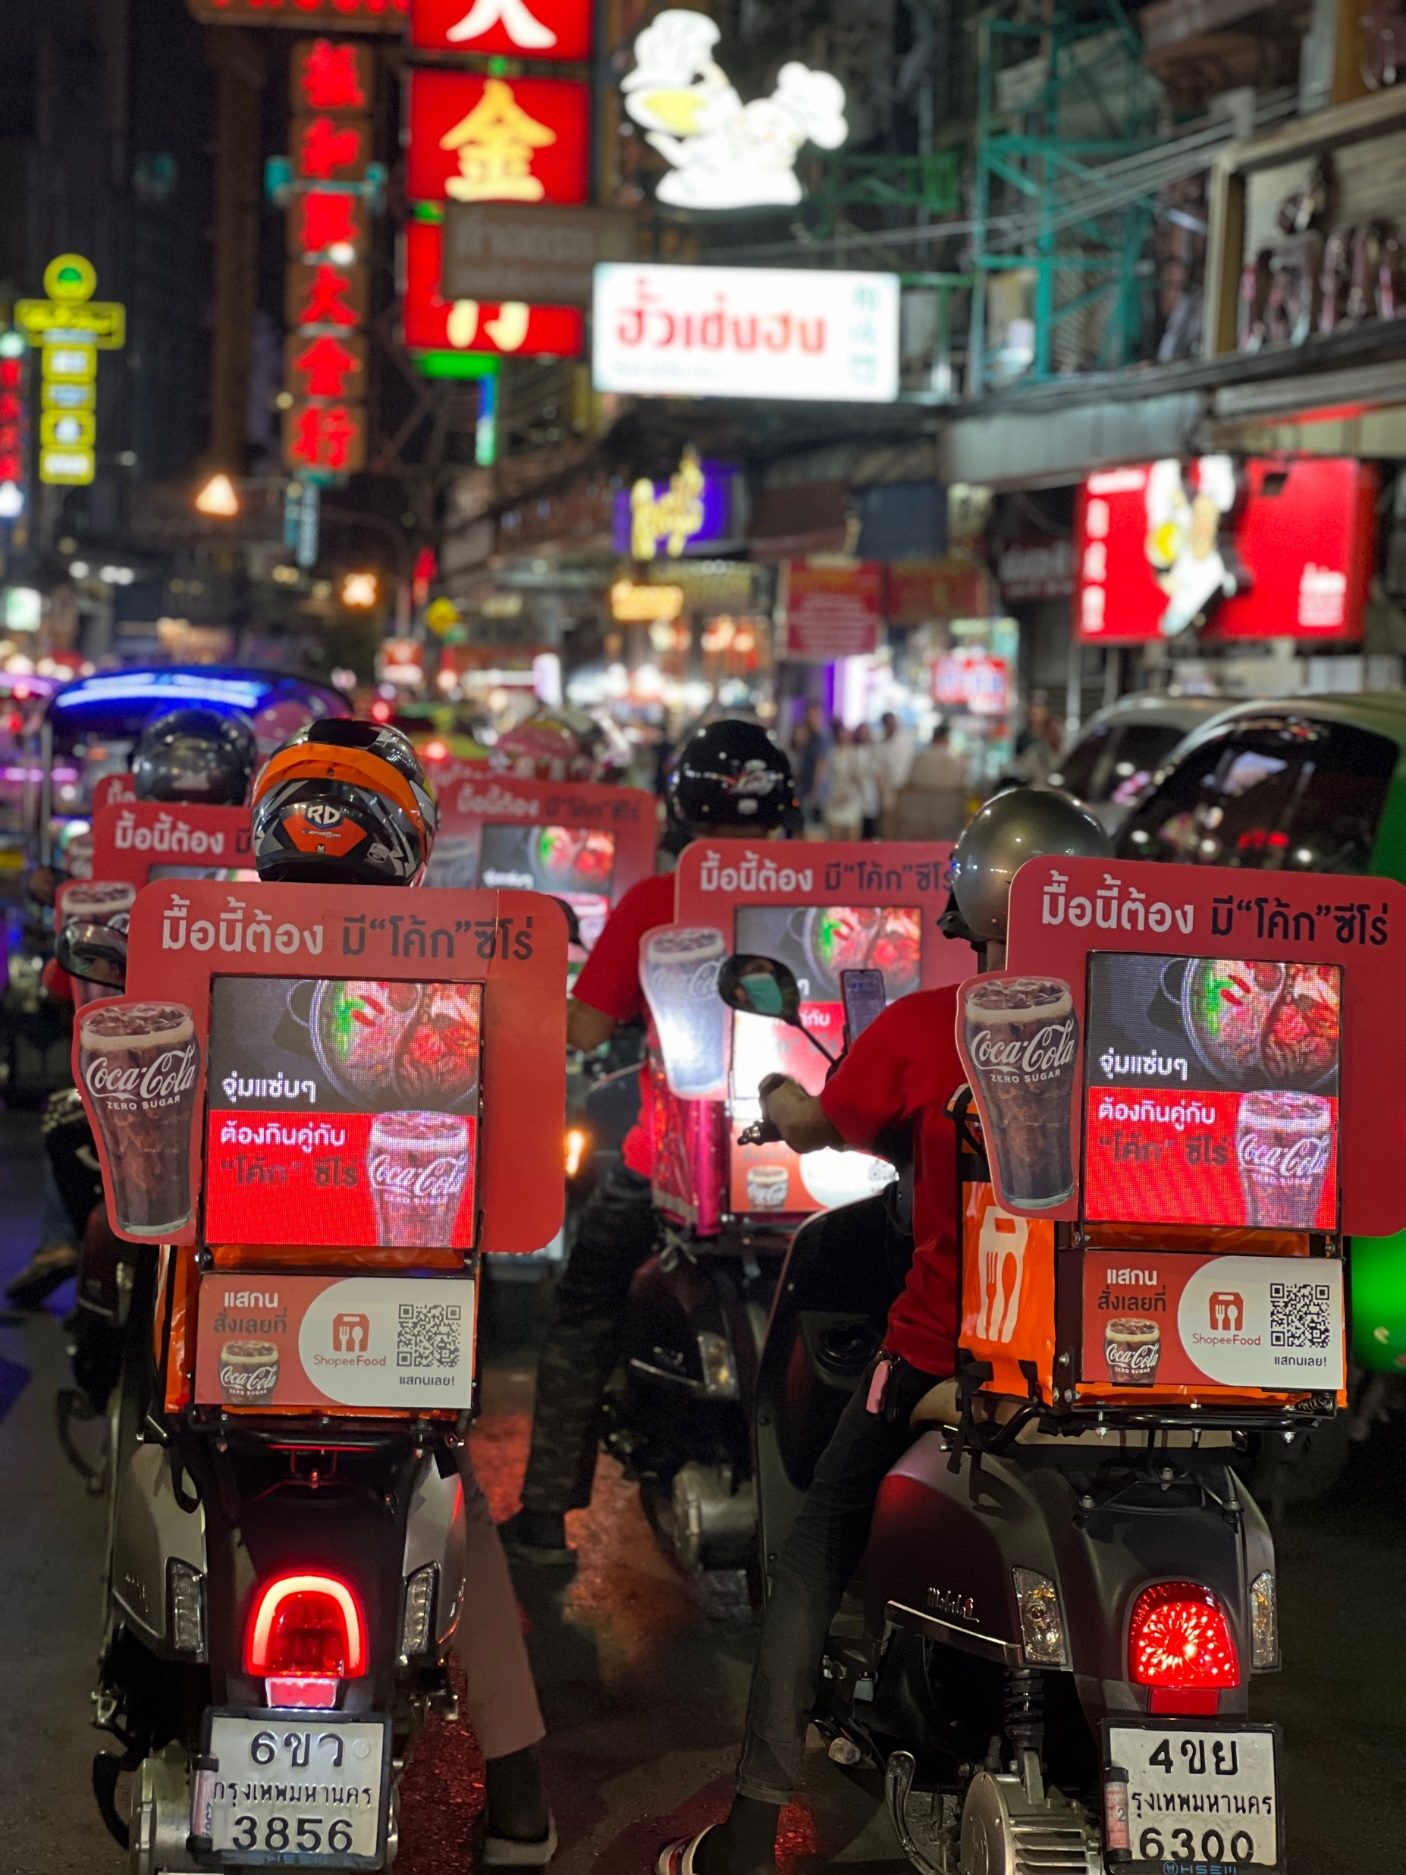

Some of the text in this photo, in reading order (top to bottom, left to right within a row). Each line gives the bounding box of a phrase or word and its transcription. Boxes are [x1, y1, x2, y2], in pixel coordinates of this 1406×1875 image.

[307, 805, 341, 825] RD
[114, 809, 225, 854] มื้อนี้ต้อง
[700, 850, 814, 893] มื้อนี้ต้อง
[1042, 869, 1195, 935] มื้อนี้ต้อง
[161, 893, 324, 956] มื้อนี้ต้อง
[971, 1018, 1075, 1074] Coca-Cola
[86, 1043, 196, 1100] Coca-Cola
[991, 1069, 1061, 1084] ZERO SUGAR
[1099, 1047, 1189, 1082] จุ่มแซ่บๆ
[106, 1094, 181, 1111] ZERO SUGAR
[222, 1070, 317, 1104] จุ่มแซ่บๆ
[1097, 1096, 1216, 1132] ต้องกินคู่กับ
[219, 1119, 346, 1154] ต้องกินคู่กับ
[1107, 1267, 1158, 1286] แสกน
[223, 1290, 279, 1309] แสกน
[1097, 1285, 1167, 1312] สั่งเลยที่
[213, 1308, 288, 1335] สั่งเลยที่
[1192, 1333, 1262, 1347] ShopeeFood
[313, 1354, 387, 1369] ShopeeFood
[1106, 1343, 1159, 1369] Coca-Cola
[1274, 1355, 1328, 1367] แสกนเลย!
[220, 1364, 278, 1391] Coca-Cola
[399, 1375, 456, 1387] แสกนเลย!
[250, 1730, 344, 1768] 6ขว
[1149, 1738, 1239, 1776] 4ขย
[1131, 1791, 1273, 1820] รุงเทพมหานคร
[232, 1815, 353, 1853] 3856
[1139, 1827, 1255, 1863] 6300
